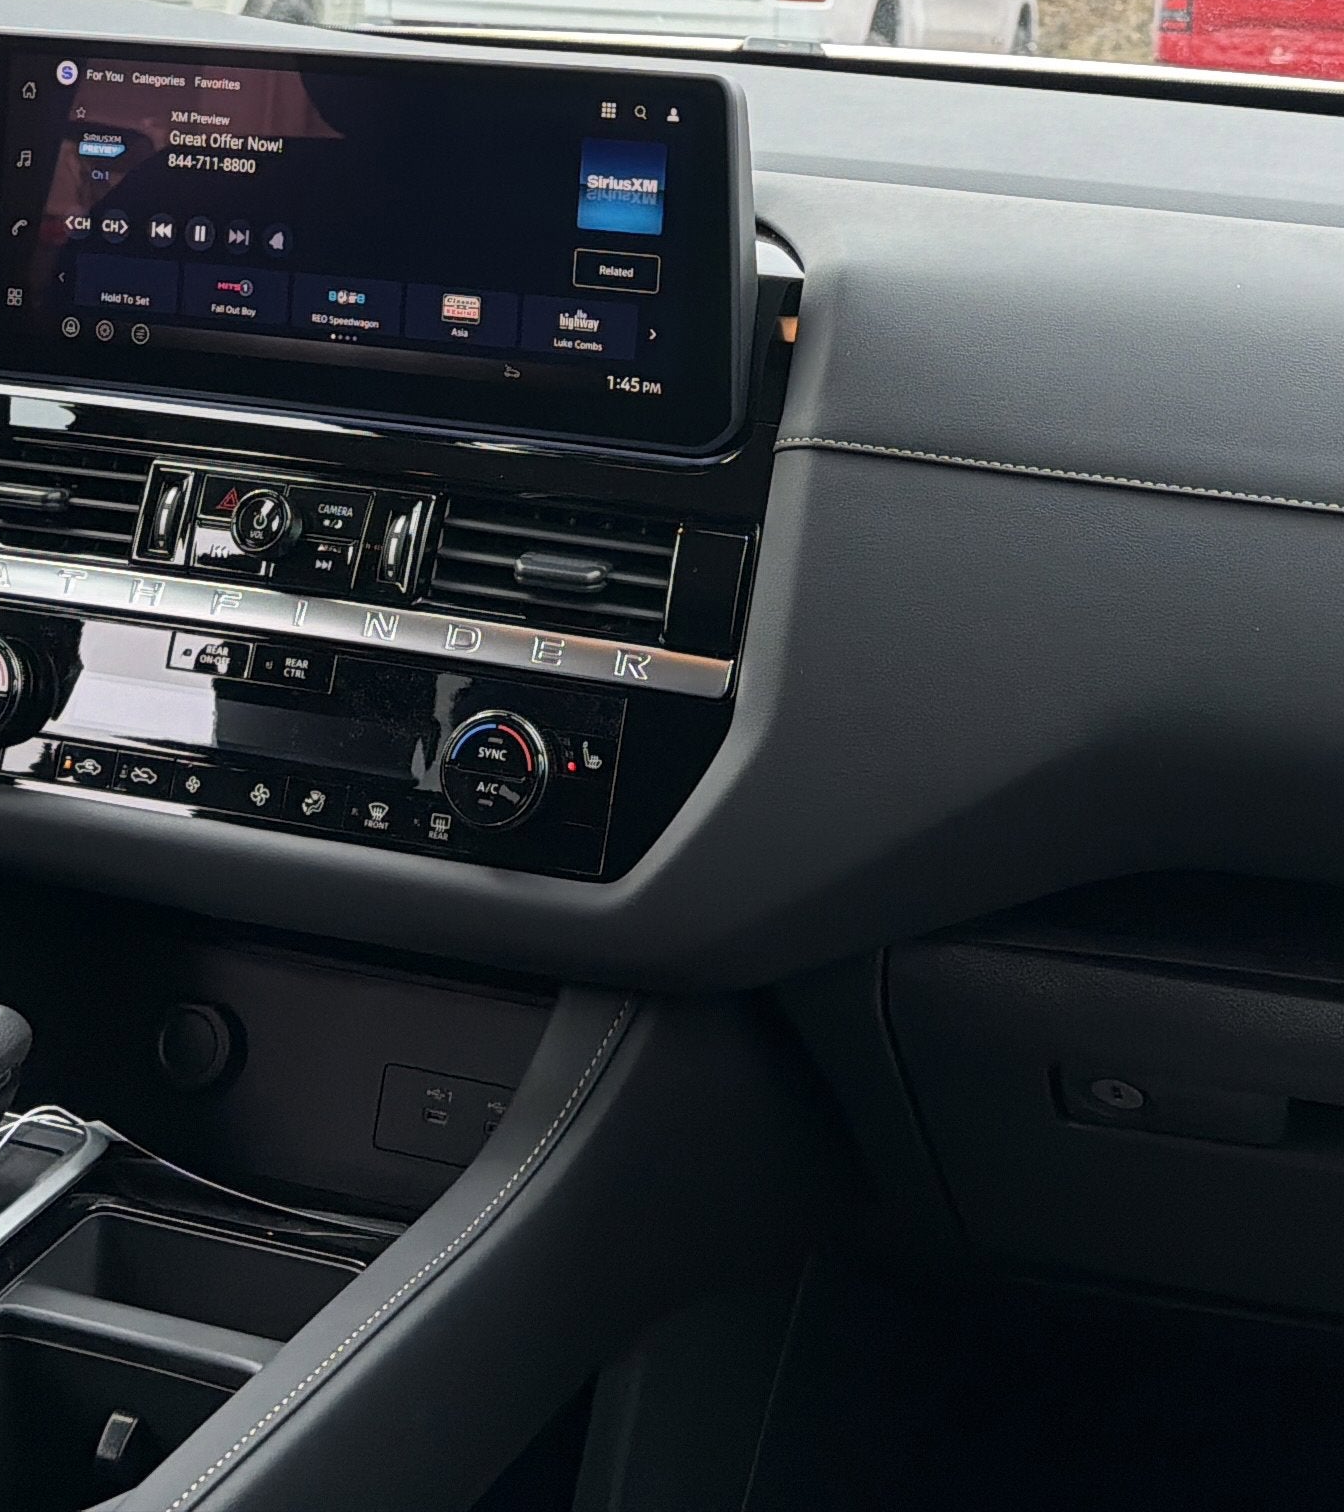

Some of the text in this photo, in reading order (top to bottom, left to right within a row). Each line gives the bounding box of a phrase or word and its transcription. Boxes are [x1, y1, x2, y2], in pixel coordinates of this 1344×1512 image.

[86, 69, 124, 83] For You
[132, 72, 186, 87] Categories
[194, 76, 241, 90] Favorites
[171, 111, 230, 126] XM Preview
[169, 130, 283, 153] Great Offer Now!
[83, 144, 120, 154] PREVIEW
[168, 153, 257, 174] 844-711-8800
[91, 170, 102, 180] Ch
[586, 174, 658, 193] SiriusXM
[598, 265, 634, 278] Related
[101, 292, 150, 306] Hold To Set
[212, 304, 256, 318] Fall Out Boy
[329, 315, 379, 329] Speedwagon
[560, 313, 599, 332] highway
[451, 328, 468, 338] Asia
[554, 338, 603, 351] Luke Combs
[606, 374, 662, 394] 1:45 PM
[317, 504, 354, 517] CAMERA
[250, 531, 264, 539] VOL
[206, 646, 228, 656] REAR
[285, 658, 309, 668] REAR
[283, 668, 306, 679] CTRL
[478, 746, 508, 761] SYNC
[476, 782, 498, 794] A/C
[364, 819, 390, 830] FRONT
[428, 830, 448, 840] REAR
